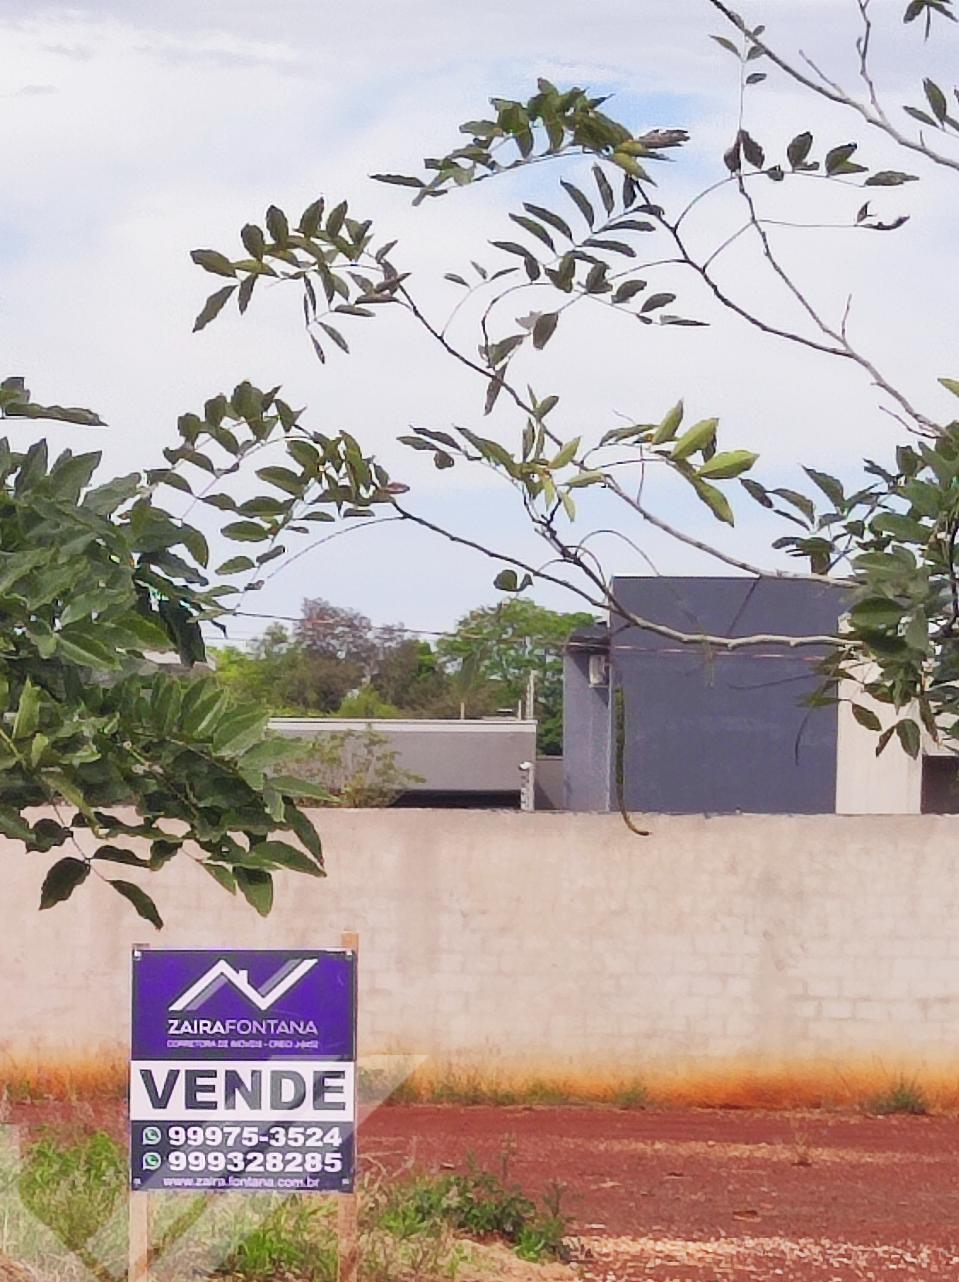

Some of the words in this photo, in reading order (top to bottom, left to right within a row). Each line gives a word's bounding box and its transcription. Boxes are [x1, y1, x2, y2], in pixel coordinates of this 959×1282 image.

[139, 1069, 346, 1111] VENDE
[168, 1126, 343, 1147] 99975-3524
[168, 1152, 343, 1172] 999328285
